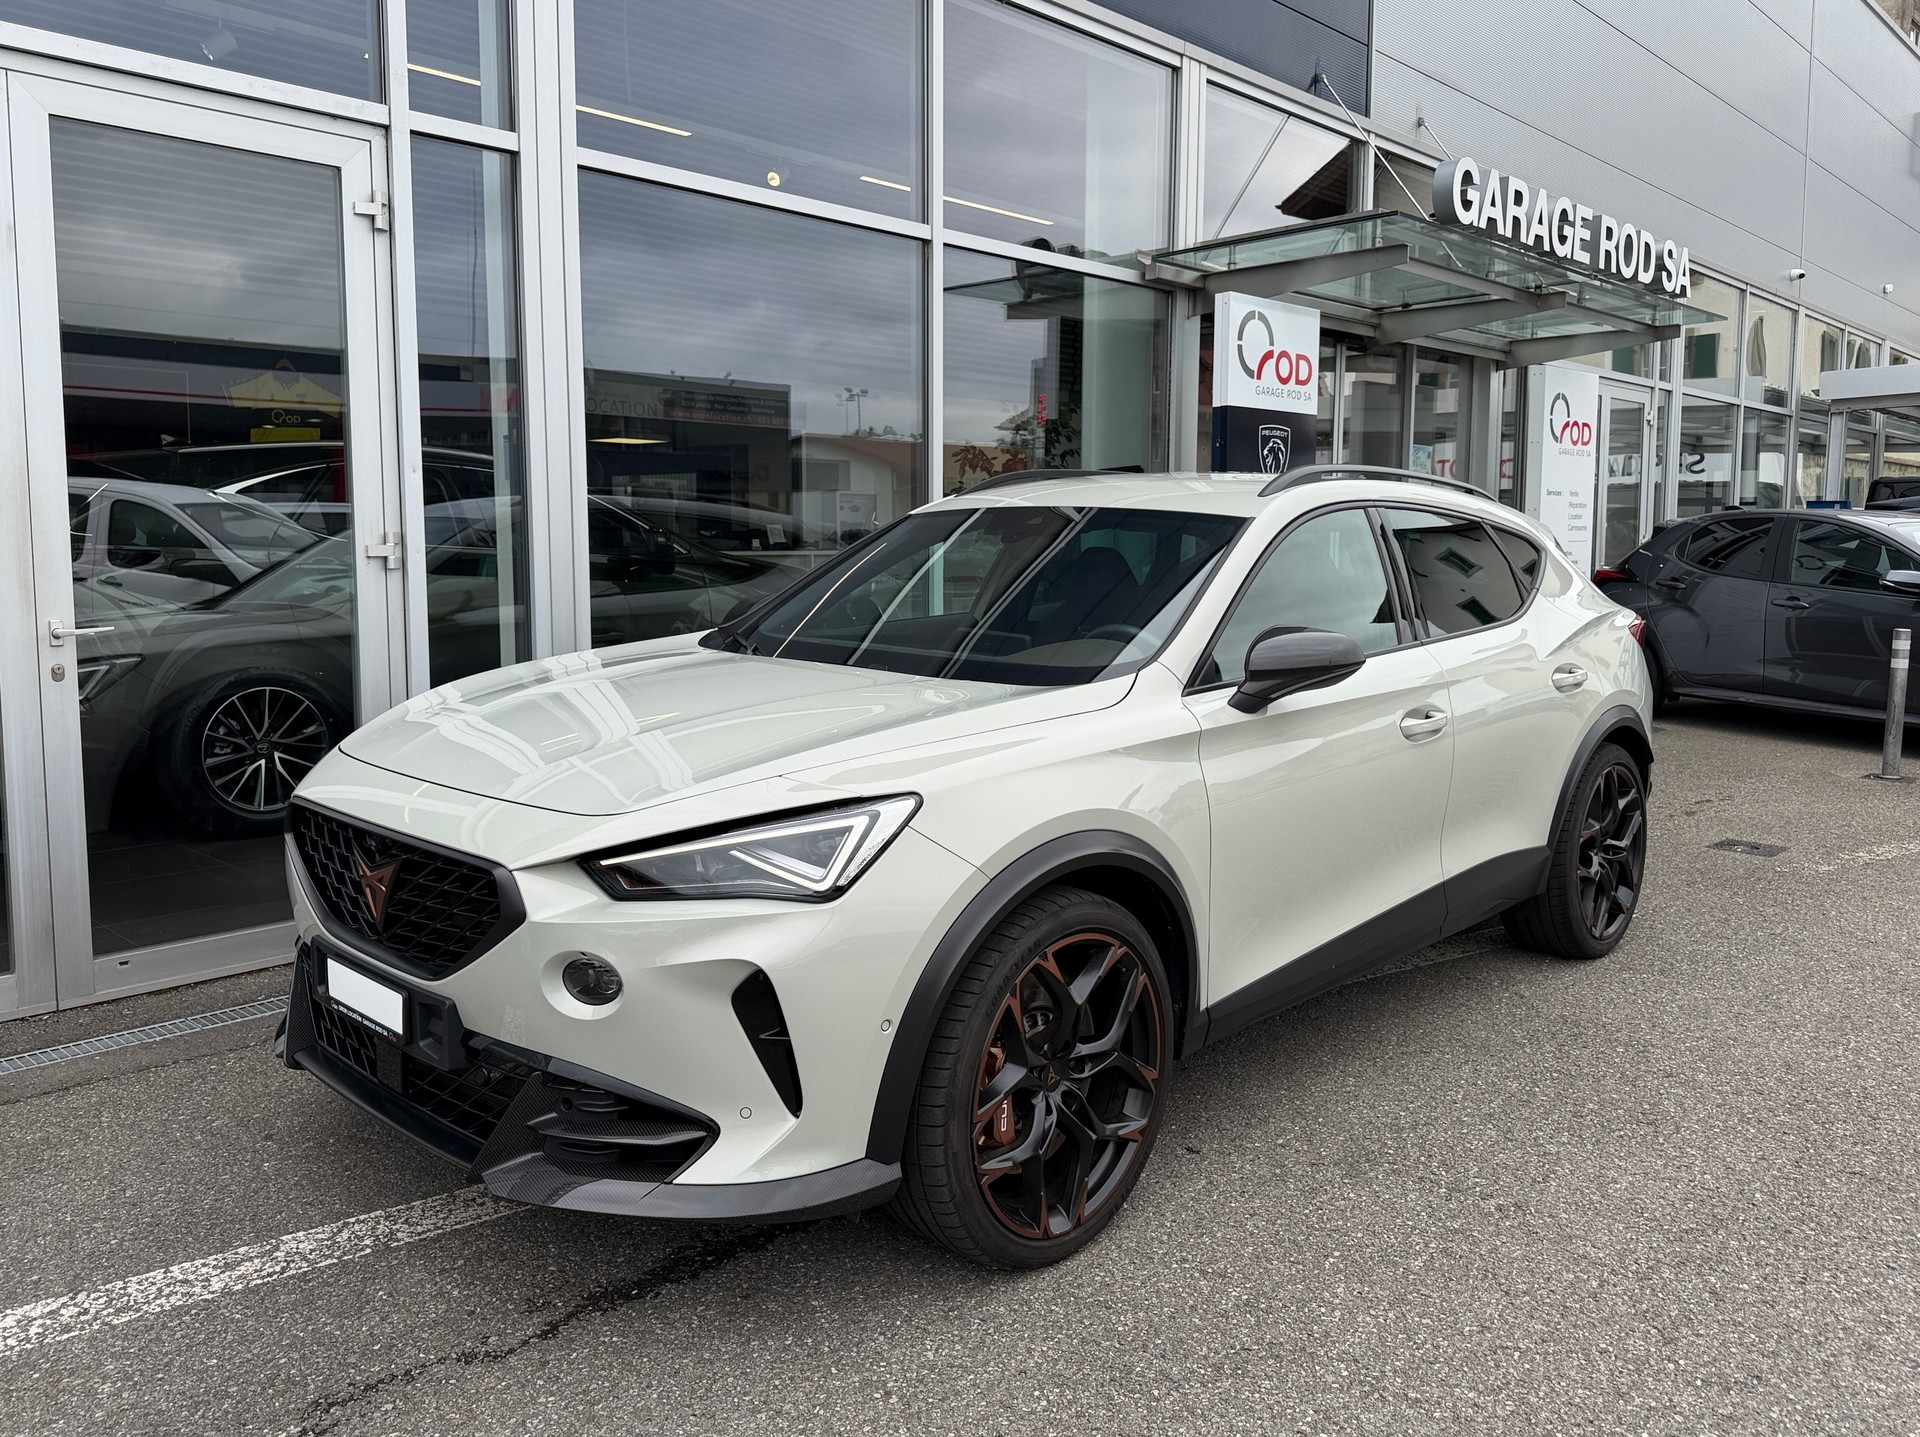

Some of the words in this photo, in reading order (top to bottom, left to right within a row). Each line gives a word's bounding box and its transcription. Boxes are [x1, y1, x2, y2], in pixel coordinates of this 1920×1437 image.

[1453, 157, 1593, 265] GARAGE
[1599, 214, 1656, 285] ROD
[1661, 240, 1692, 298] SA
[1255, 385, 1285, 398] GARAGE
[1286, 389, 1302, 401] ROD
[1303, 391, 1312, 402] SA
[1262, 429, 1288, 438] PEUGEOT
[1559, 447, 1575, 456] GARAGE
[1576, 449, 1585, 457] ROD
[1586, 450, 1591, 458] SA
